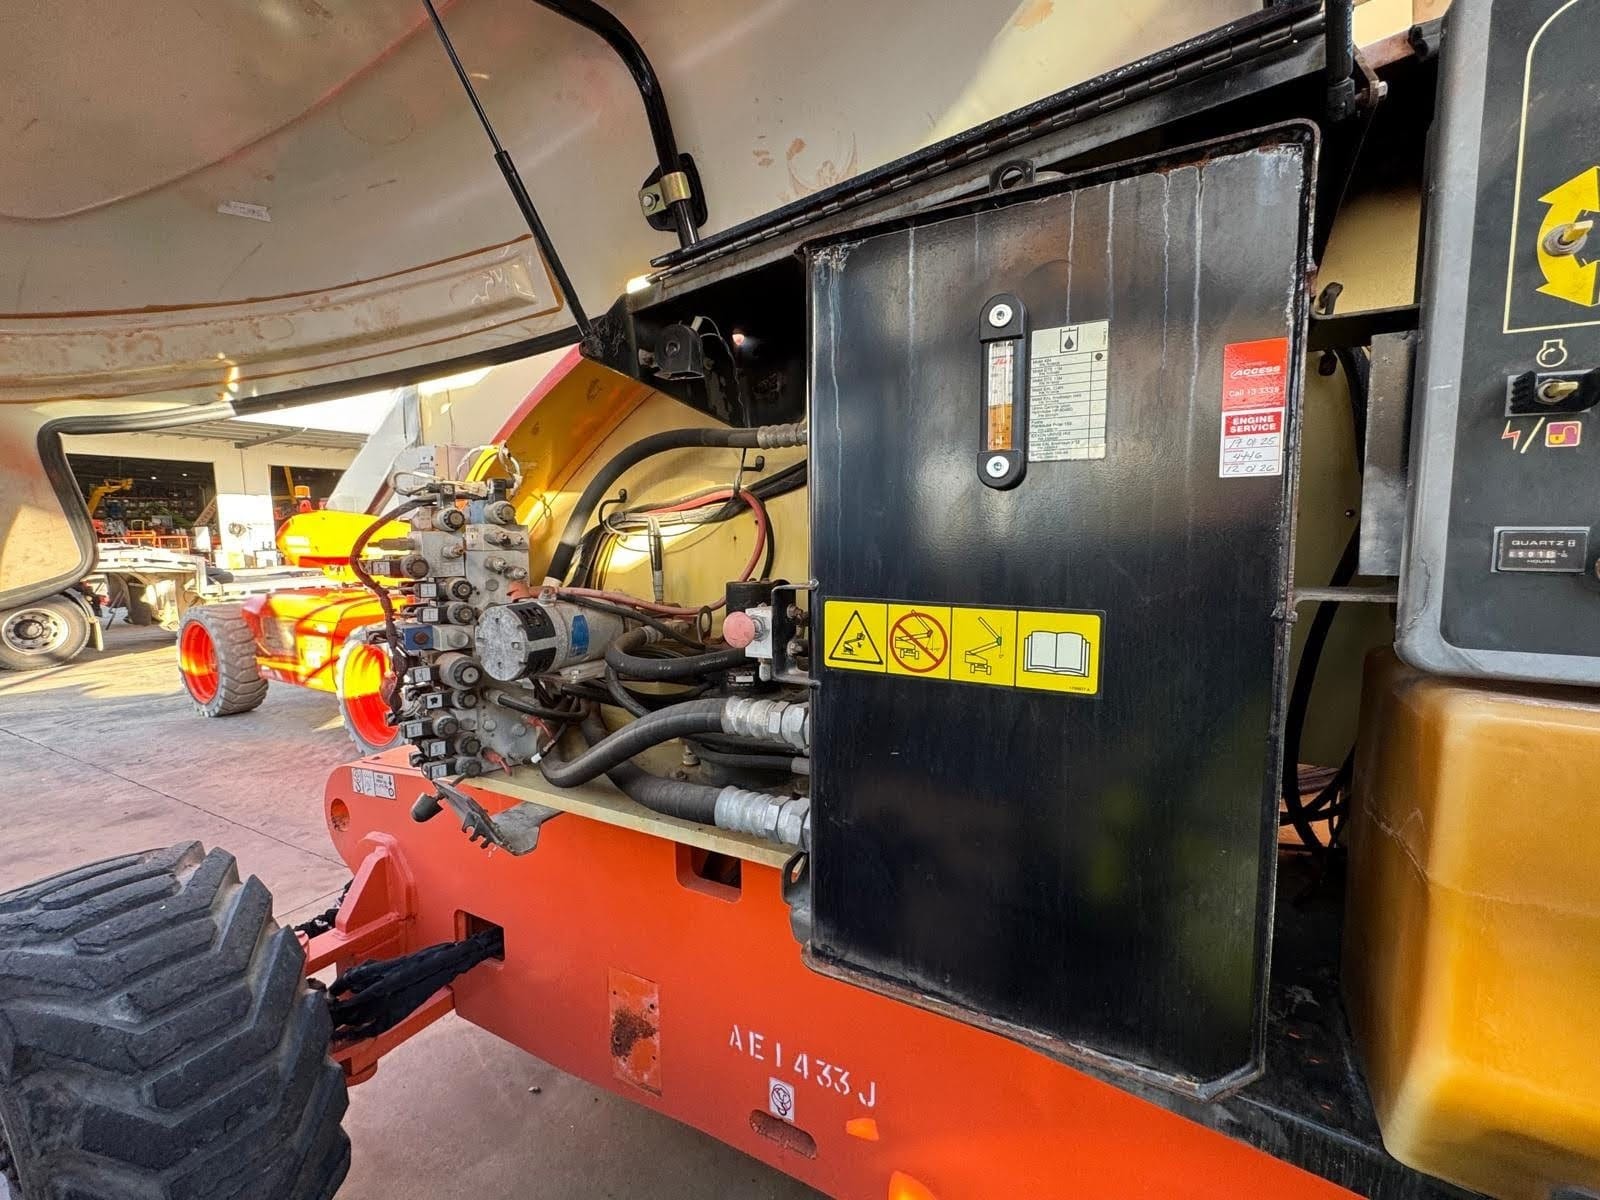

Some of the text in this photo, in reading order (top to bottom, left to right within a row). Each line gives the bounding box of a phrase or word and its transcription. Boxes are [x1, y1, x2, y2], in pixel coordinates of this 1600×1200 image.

[1229, 389, 1244, 398] Call
[1232, 415, 1275, 425] ENGINE
[1230, 422, 1276, 433] SERVICE
